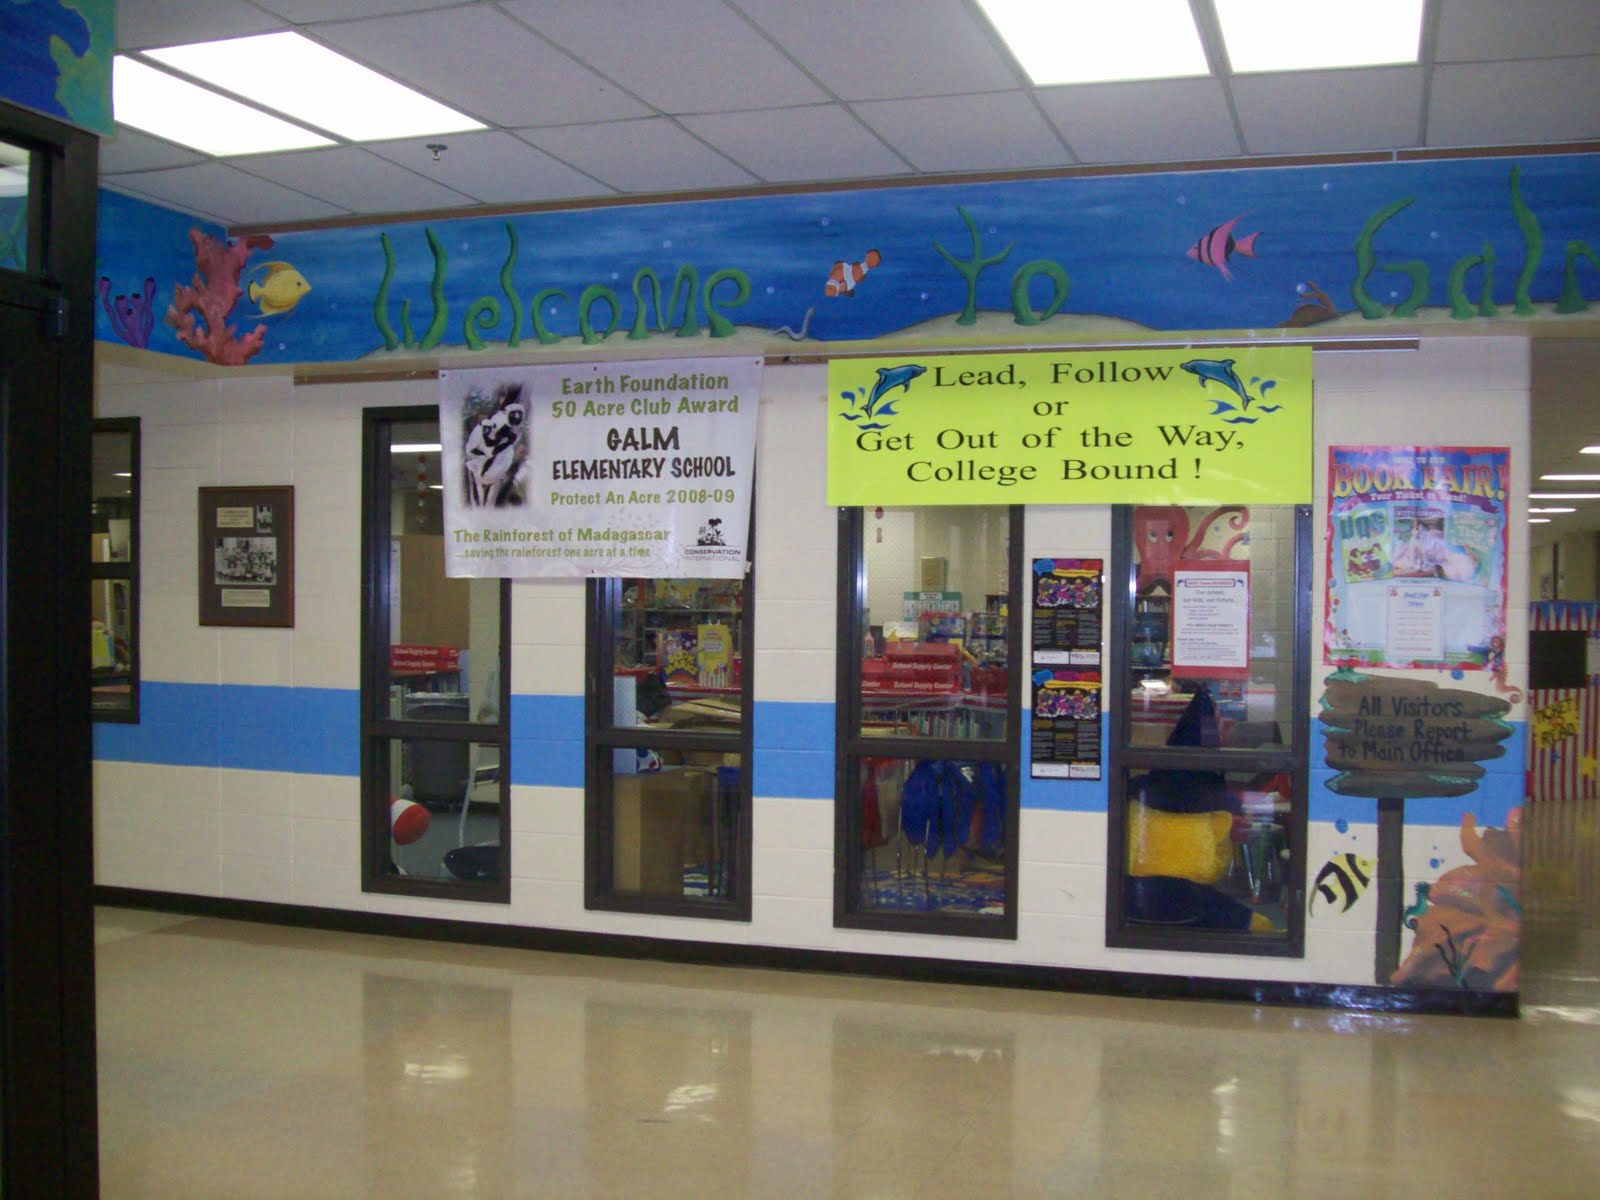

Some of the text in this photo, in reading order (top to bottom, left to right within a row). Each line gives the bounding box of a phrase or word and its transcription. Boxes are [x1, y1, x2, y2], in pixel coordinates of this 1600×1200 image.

[562, 373, 729, 395] Earth Foundation
[933, 361, 1174, 389] Lead, Follow
[552, 395, 739, 419] 50 Acre Club Award
[1033, 401, 1069, 416] or
[606, 426, 681, 451] GALM
[856, 425, 1244, 452] Get Out of the Way,
[552, 456, 736, 481] ELEMENTARY SCHOOL
[906, 459, 1037, 485] College
[1061, 458, 1178, 480] Bound
[1333, 464, 1414, 498] BOOK
[551, 492, 601, 506] Protect
[605, 491, 625, 505] An
[628, 490, 661, 504] Acre
[453, 527, 671, 544] The Rainforest of Madagascar
[496, 548, 509, 558] the
[511, 547, 562, 558] rainforest
[564, 549, 580, 558] one
[583, 549, 603, 557] acre
[606, 547, 617, 557] at
[619, 549, 626, 557] a
[628, 546, 651, 557] time
[1358, 696, 1465, 717] All Visitors
[1354, 718, 1473, 741] Please Report
[1363, 742, 1404, 760] Main
[1409, 741, 1464, 760] Office
